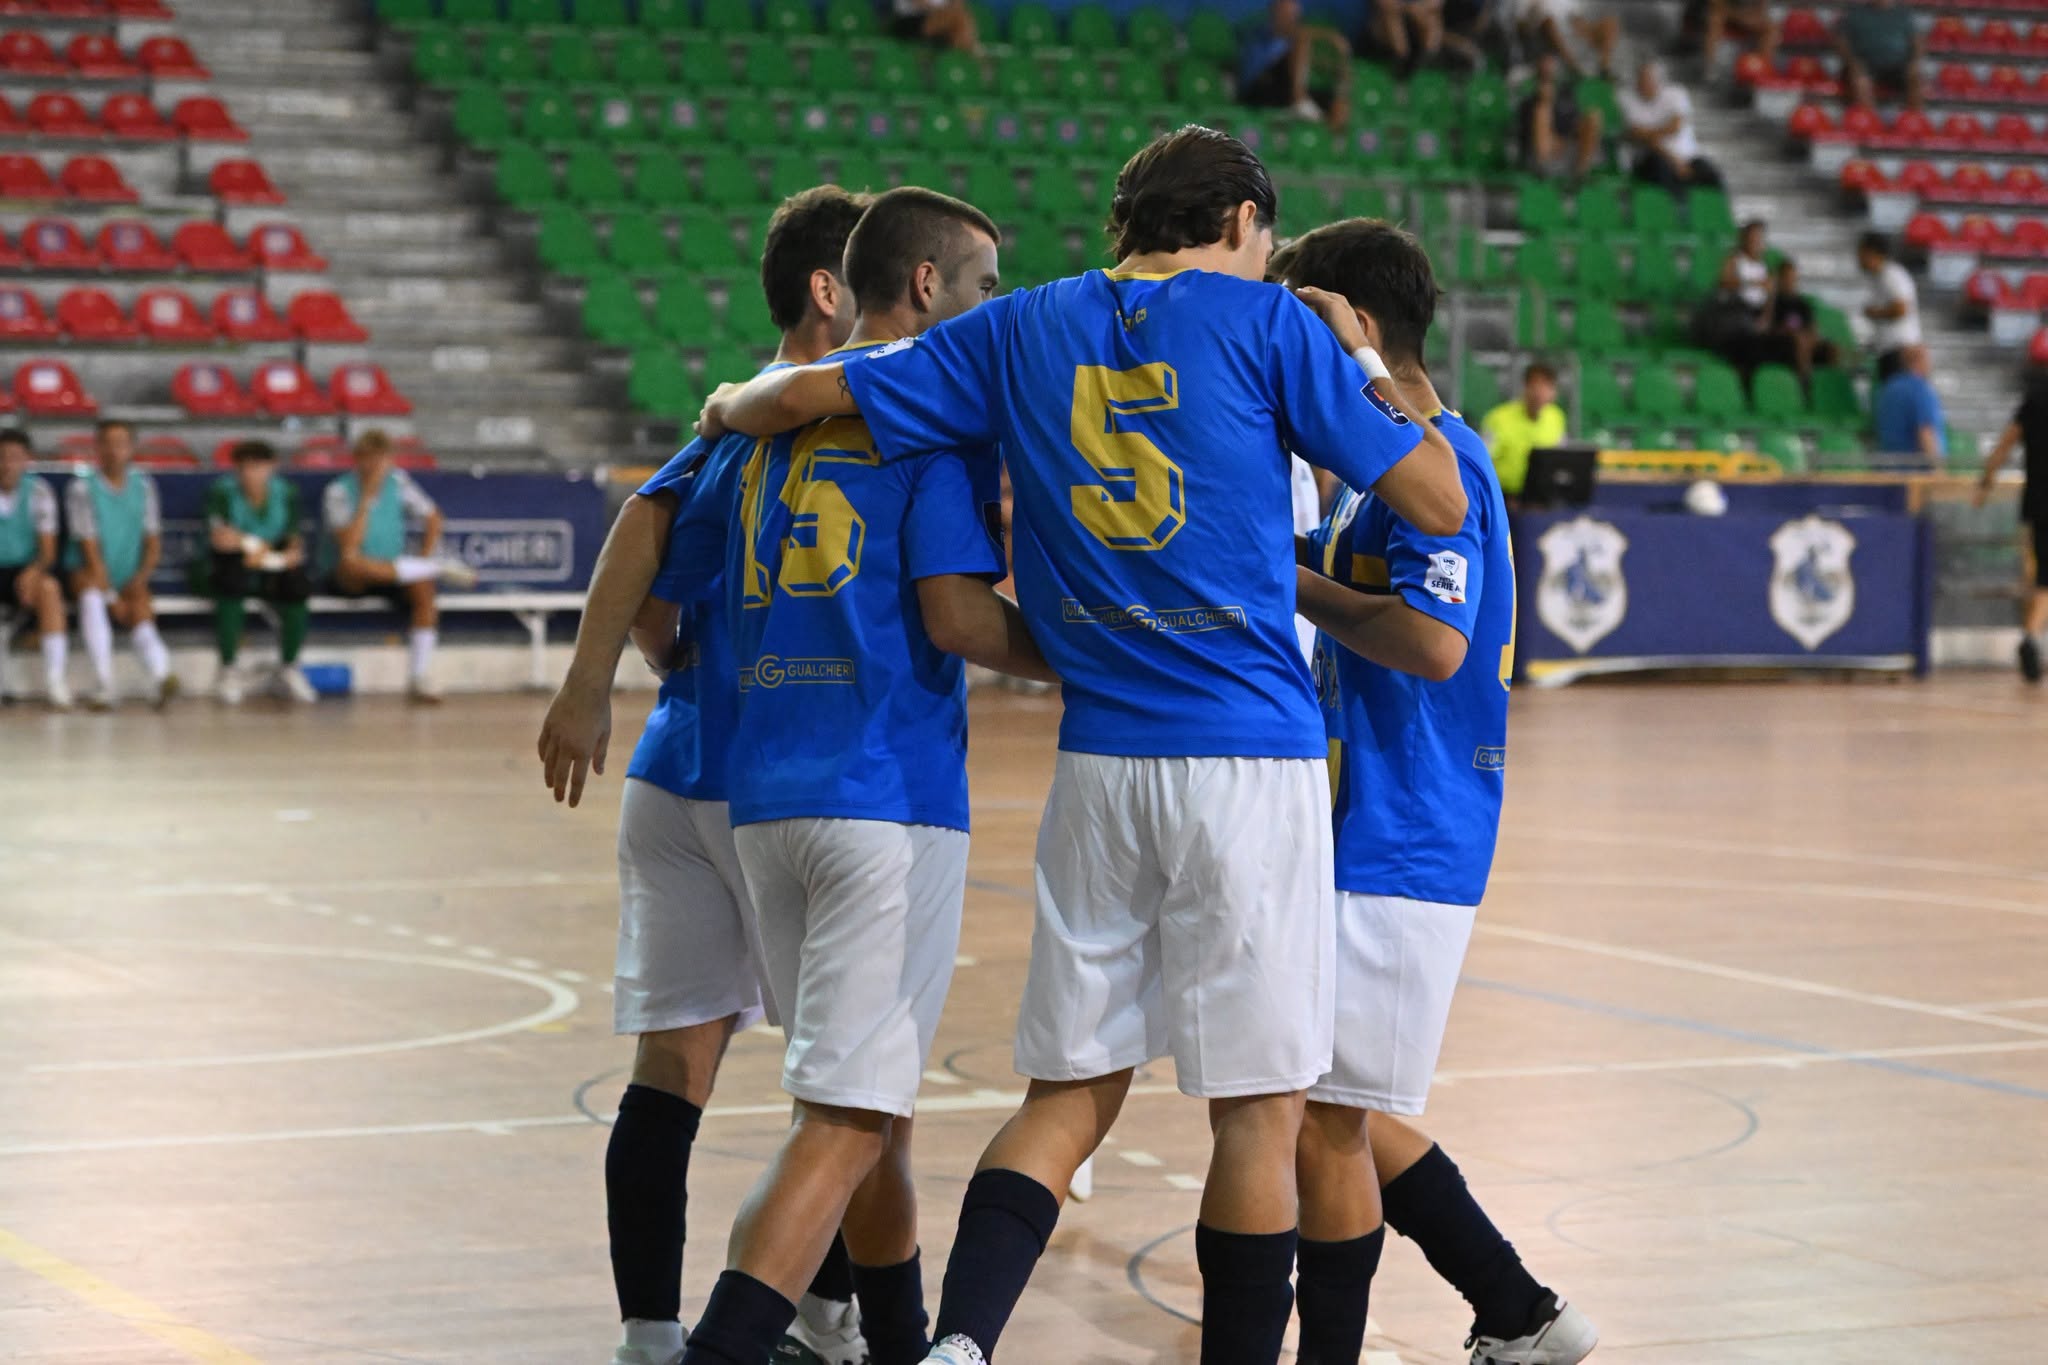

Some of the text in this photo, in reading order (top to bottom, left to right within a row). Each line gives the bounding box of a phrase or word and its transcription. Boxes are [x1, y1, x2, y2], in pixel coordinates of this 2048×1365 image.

[1070, 361, 1187, 551] 5
[1431, 580, 1453, 591] SERIE
[1158, 610, 1241, 629] GUALCHIERI
